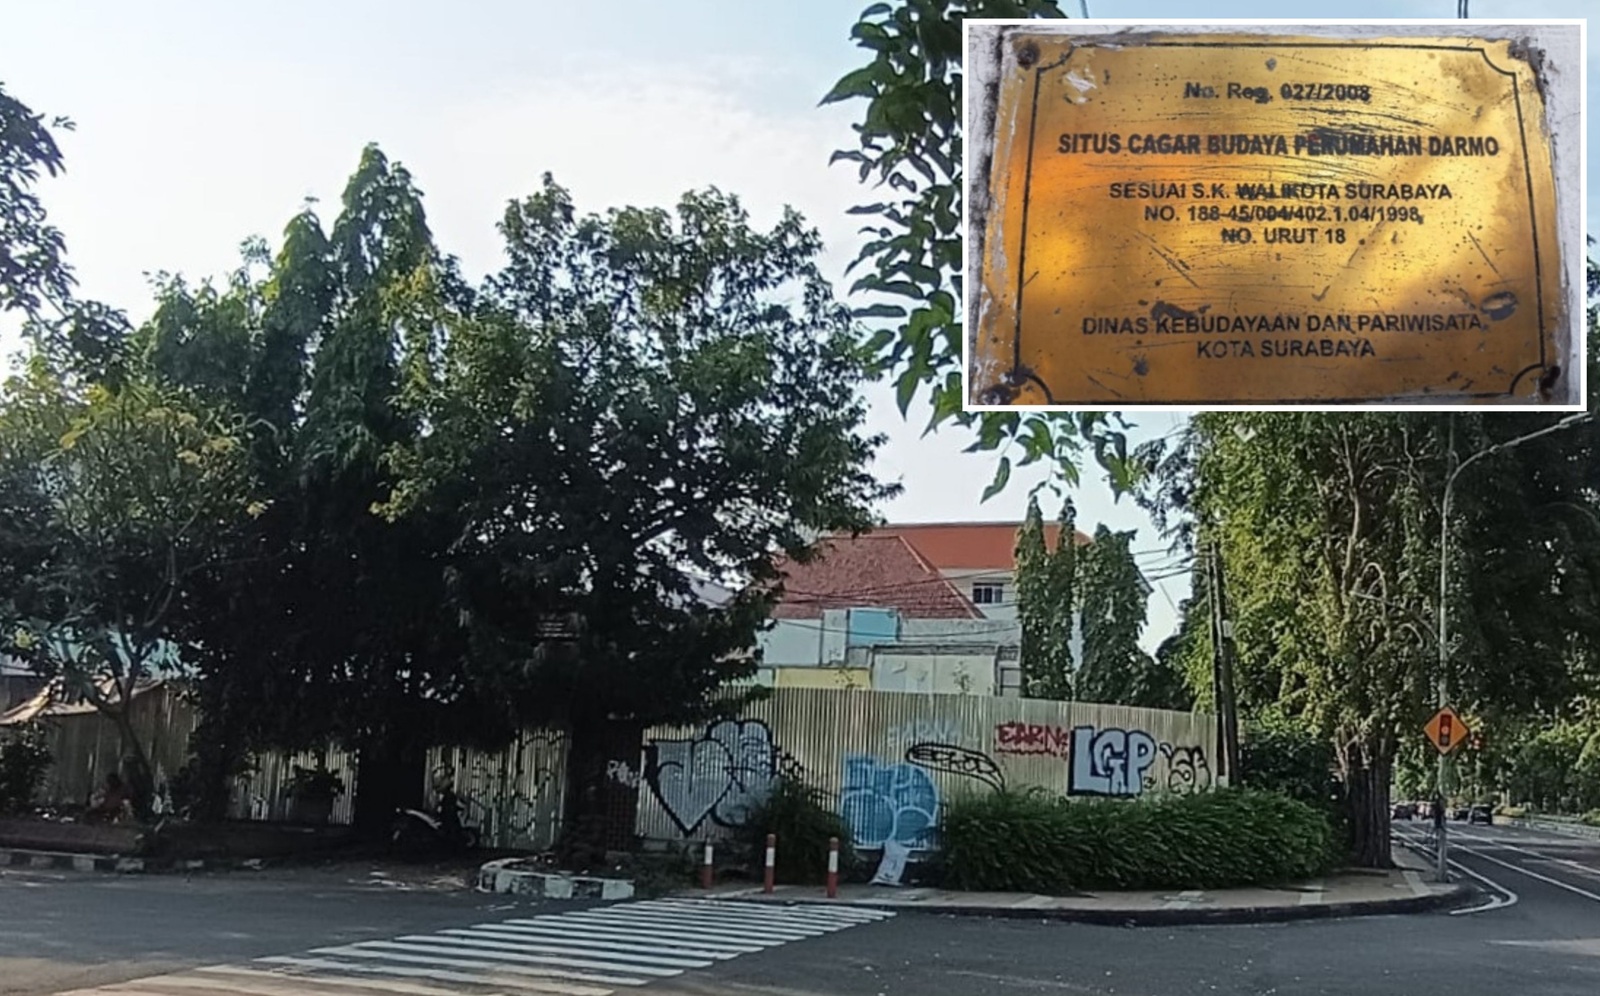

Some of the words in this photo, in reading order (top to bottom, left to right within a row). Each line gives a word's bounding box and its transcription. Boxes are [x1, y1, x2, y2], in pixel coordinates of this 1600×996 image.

[1183, 81, 1219, 99] No.
[1228, 82, 1273, 104] Reg.
[1281, 83, 1371, 102] 027/2008
[1058, 133, 1121, 155] SITUS
[1128, 133, 1201, 155] CAGAR
[1207, 134, 1288, 155] BUDAYA
[1428, 136, 1499, 157] DARMO
[1109, 183, 1186, 199] SESUAI
[1192, 183, 1230, 199] S.K.
[1235, 183, 1340, 200] WALIKOTA
[1345, 184, 1453, 200] SURABAYA
[1144, 205, 1180, 221] NO.
[1221, 228, 1257, 245] NO.
[1264, 228, 1318, 244] URUT
[1325, 228, 1346, 244] 18
[1082, 317, 1148, 335] DINAS
[1155, 316, 1300, 335] KEBUDAYAAN
[1307, 315, 1351, 332] DAN
[1357, 313, 1482, 332] PARIWISATA
[1197, 340, 1255, 358] KOTA
[1260, 339, 1376, 358] SURABAYA
